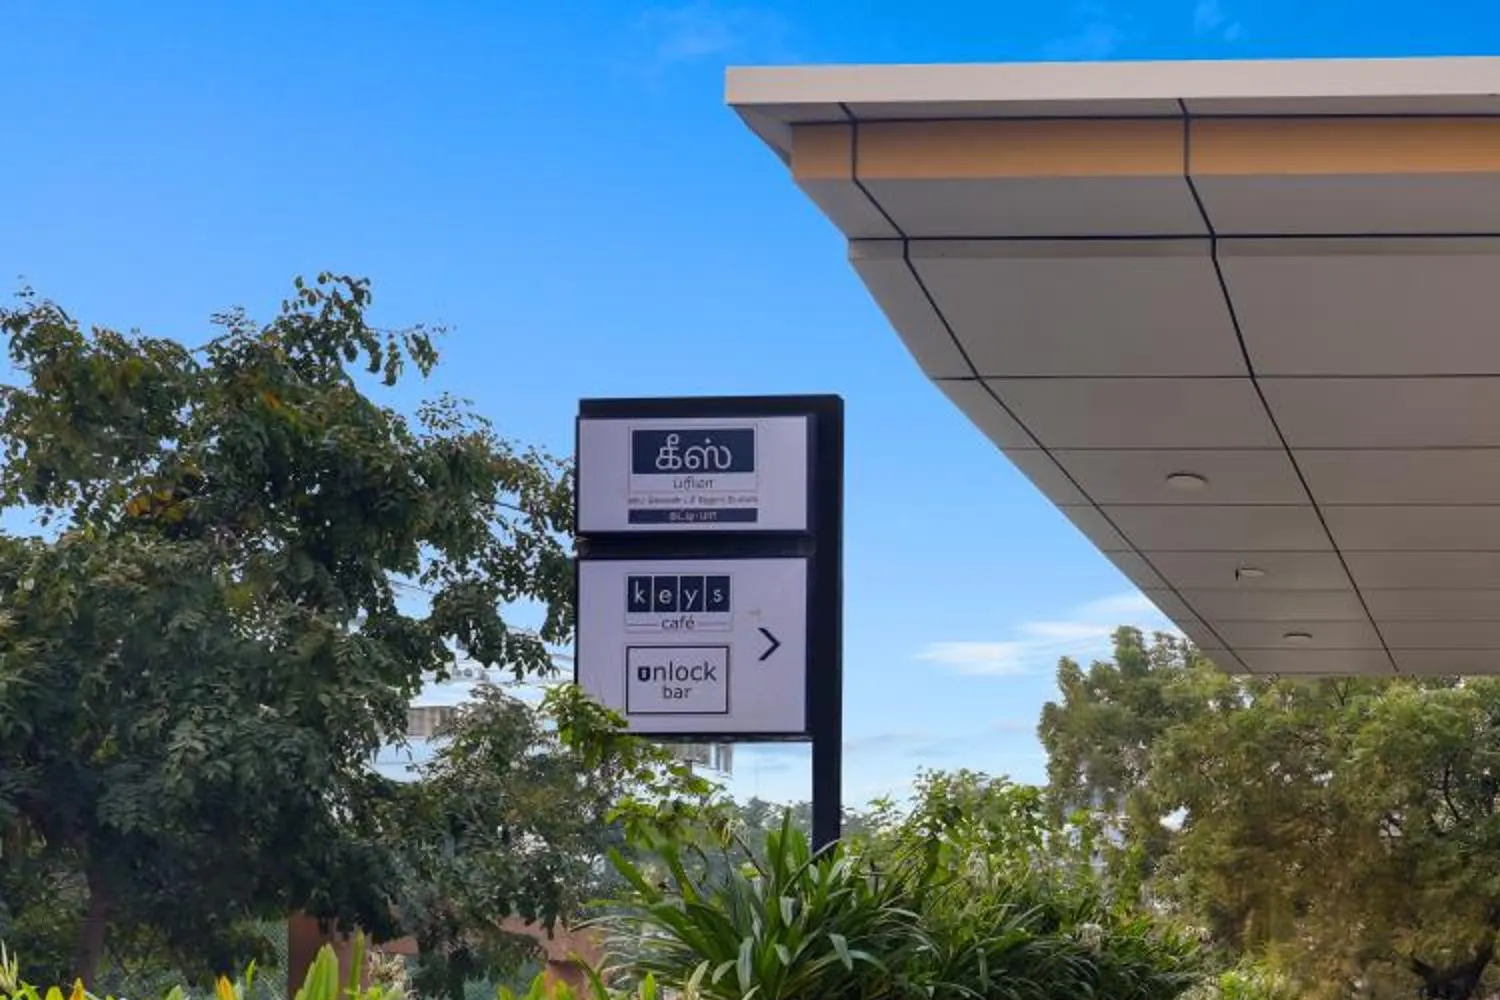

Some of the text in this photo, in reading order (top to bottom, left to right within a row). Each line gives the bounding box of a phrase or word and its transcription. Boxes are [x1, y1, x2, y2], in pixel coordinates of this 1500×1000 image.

[634, 580, 723, 610] keys
[661, 615, 695, 630] café
[637, 660, 717, 682] unlock
[662, 686, 692, 699] bar
